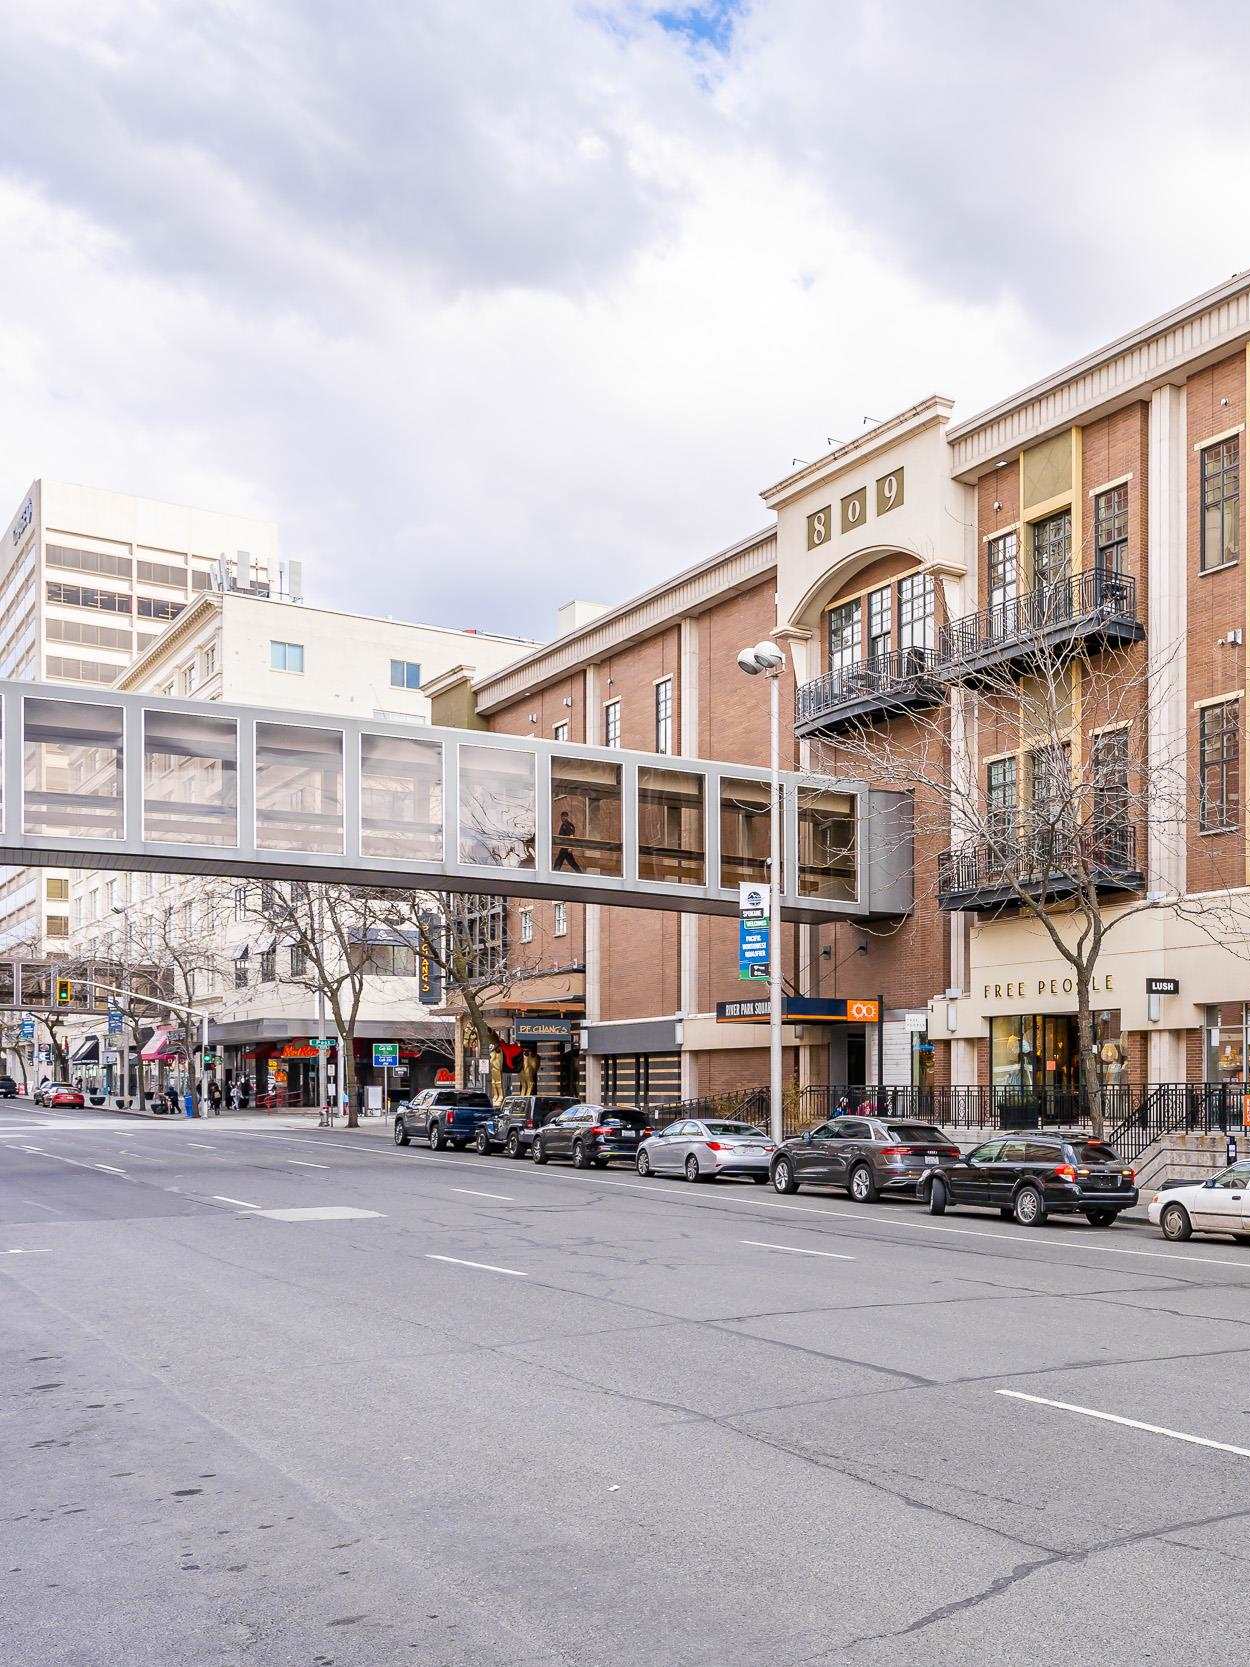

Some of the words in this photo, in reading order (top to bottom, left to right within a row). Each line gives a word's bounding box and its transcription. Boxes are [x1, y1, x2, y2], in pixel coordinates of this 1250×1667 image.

[813, 476, 898, 545] 809
[984, 982, 1025, 999] FREE
[1038, 975, 1114, 995] PEOLE
[1152, 982, 1174, 991] LUSH
[726, 1004, 740, 1016] RIVER
[741, 1003, 754, 1015] PARK
[754, 1002, 772, 1014] SQUAR
